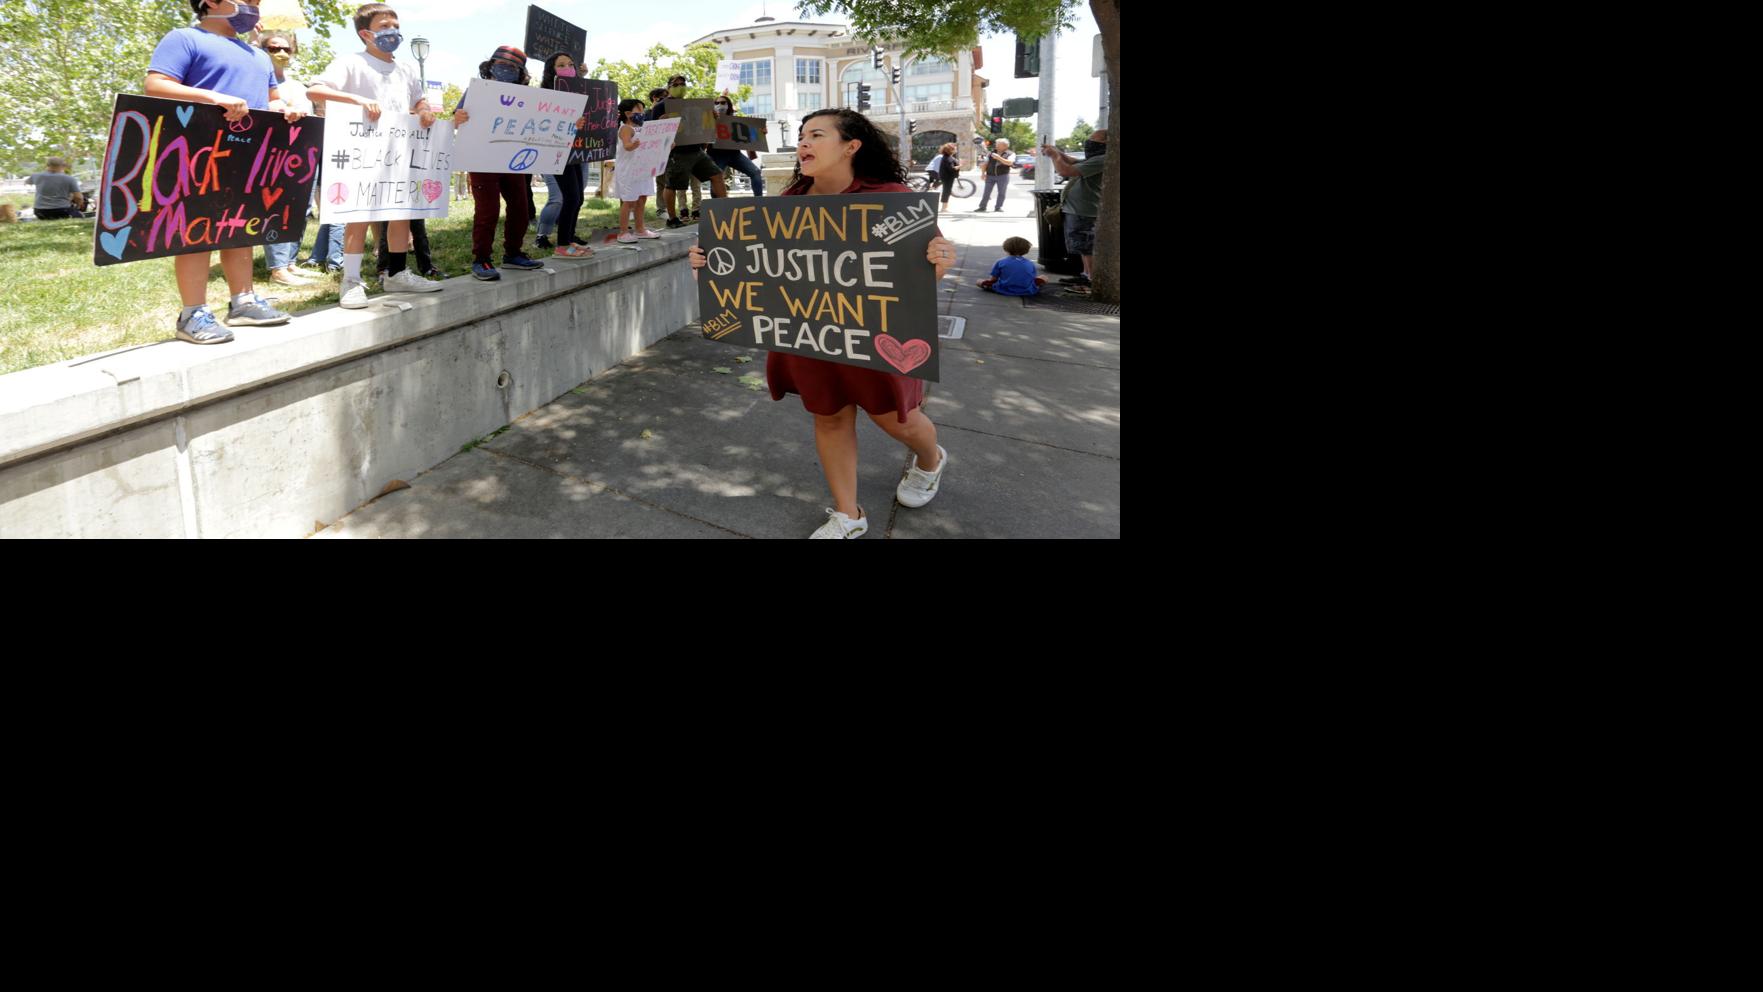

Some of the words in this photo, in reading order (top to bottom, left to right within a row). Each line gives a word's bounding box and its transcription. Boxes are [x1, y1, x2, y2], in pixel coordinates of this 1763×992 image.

[536, 101, 577, 117] WANT
[389, 127, 407, 138] FOR
[101, 110, 232, 230] Black
[244, 126, 318, 194] lives
[331, 147, 402, 170] #BLACK
[409, 149, 451, 171] LIVES
[146, 202, 290, 253] Matter!
[709, 206, 757, 241] WE
[762, 204, 884, 242] WANT
[871, 199, 935, 240] #BLM
[746, 243, 894, 288] JUSTICE
[702, 309, 738, 334] #BLM
[709, 280, 764, 312] WE
[779, 286, 899, 332] WANT
[752, 315, 871, 361] PEACE
